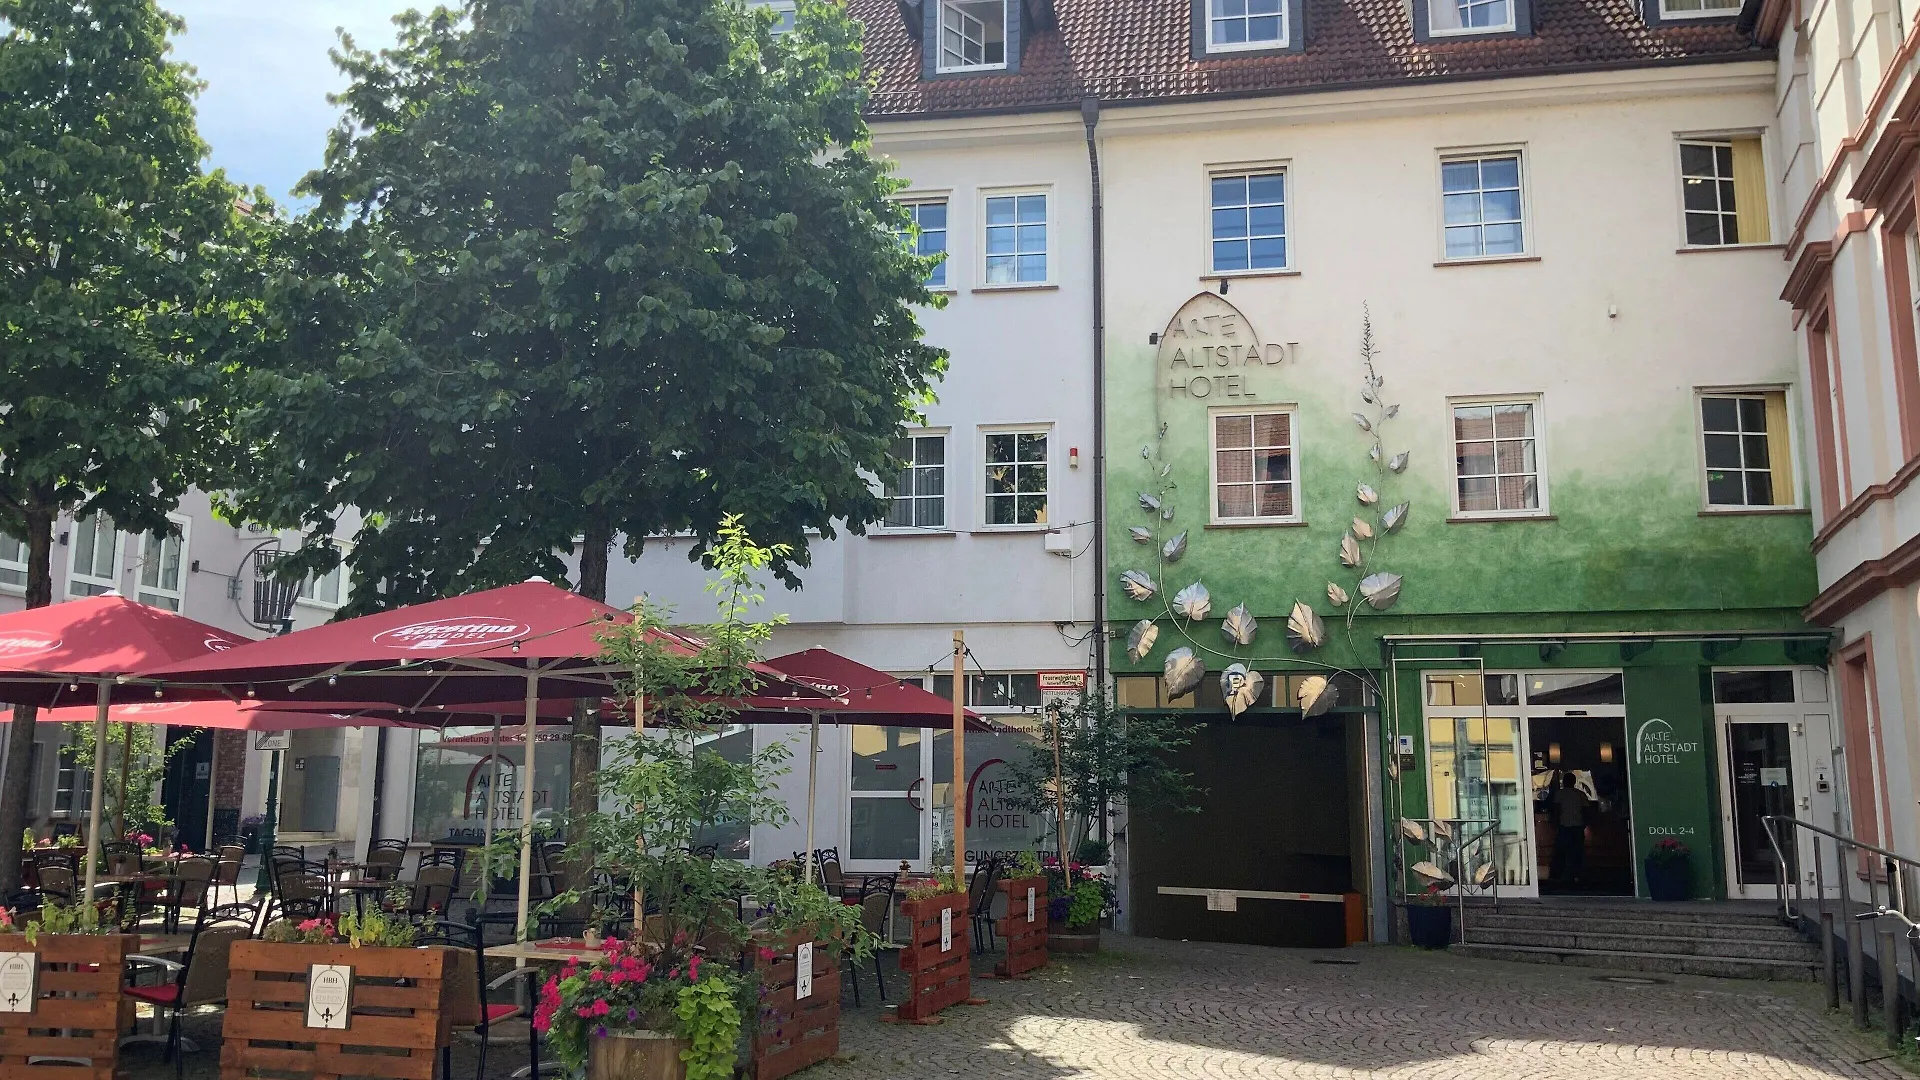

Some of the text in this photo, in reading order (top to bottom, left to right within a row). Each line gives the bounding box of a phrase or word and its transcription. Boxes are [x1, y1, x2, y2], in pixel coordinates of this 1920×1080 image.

[1172, 314, 1236, 338] ARTE
[1170, 343, 1299, 369] ALTSTADT
[1170, 374, 1256, 398] HOTEL
[402, 632, 488, 642] SPRUDEL
[443, 735, 489, 745] Vermietung
[1644, 731, 1671, 741] ARTE
[1644, 742, 1698, 752] ALTSTADT
[1644, 754, 1680, 764] HOTEL
[979, 779, 1016, 794] ARTE
[978, 814, 1029, 828] HOTEL
[1648, 826, 1694, 835] DOLL 2-4
